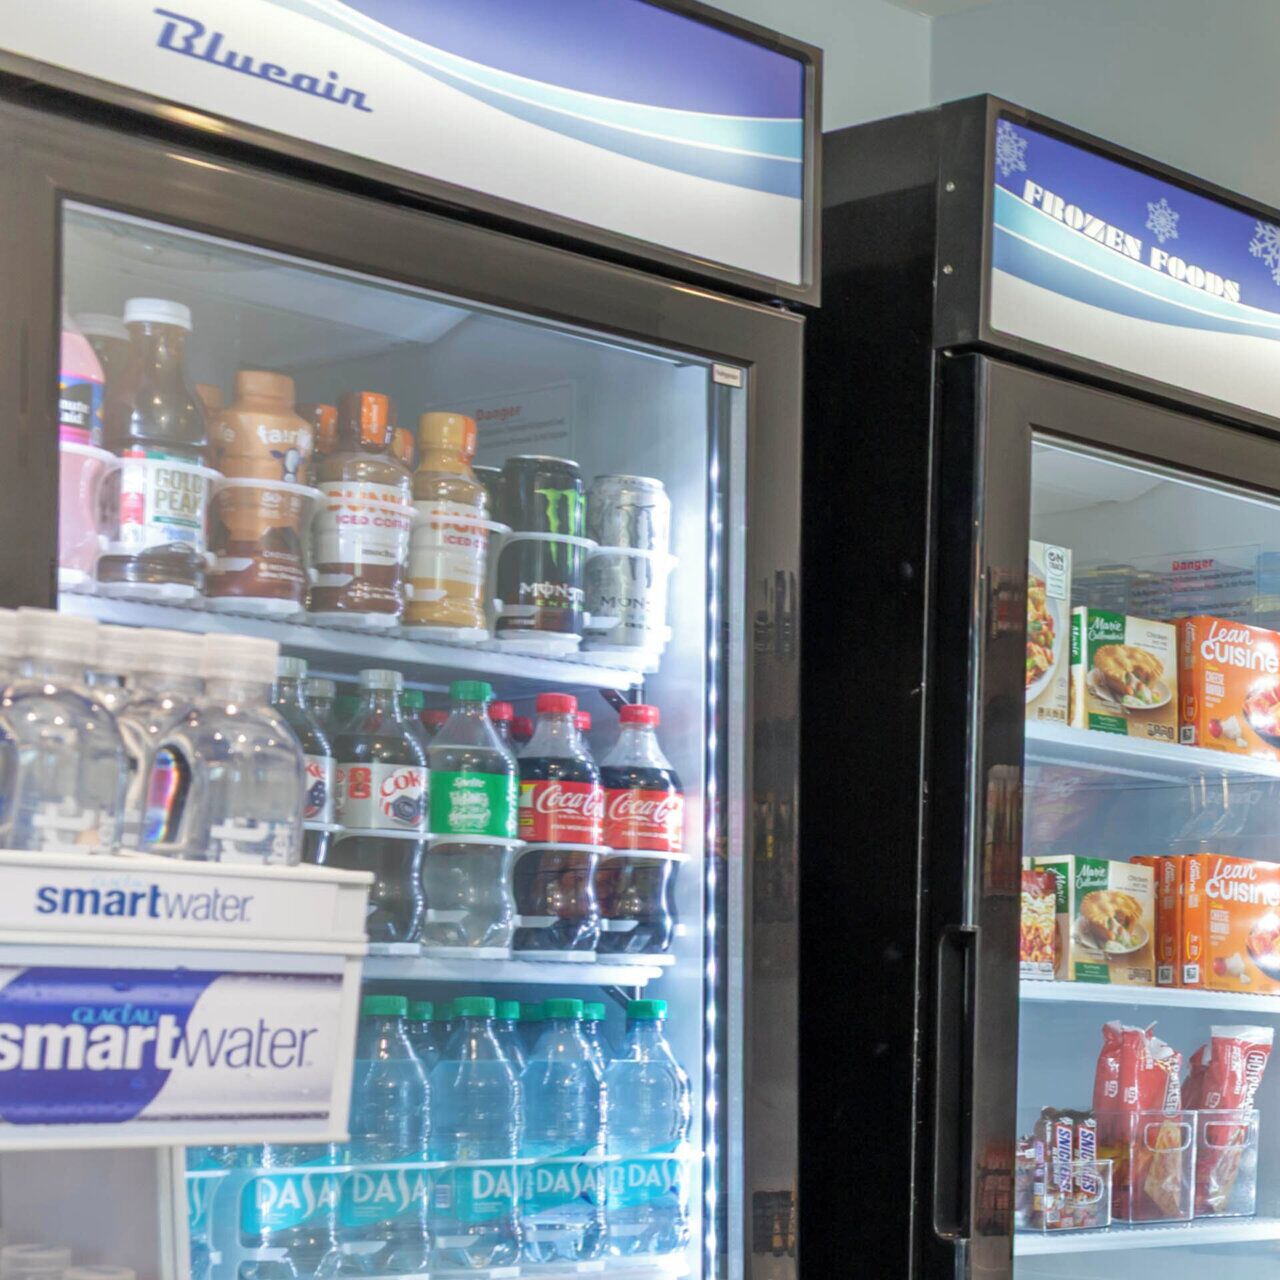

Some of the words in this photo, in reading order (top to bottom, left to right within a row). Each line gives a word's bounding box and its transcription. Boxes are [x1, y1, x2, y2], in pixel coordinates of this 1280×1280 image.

[154, 8, 374, 112] Blueair
[1022, 179, 1142, 262] FROZEN
[1149, 246, 1241, 304] FOODS
[336, 515, 368, 525] ICED
[443, 535, 472, 546] ICED
[1172, 557, 1214, 571] Danger
[1088, 616, 1122, 632] Marie
[1207, 621, 1253, 644] Lean
[1213, 858, 1257, 880] Lean
[36, 884, 253, 922] smartwater
[1056, 1127, 1073, 1192] SNICKERS
[536, 1162, 604, 1199] DASAN
